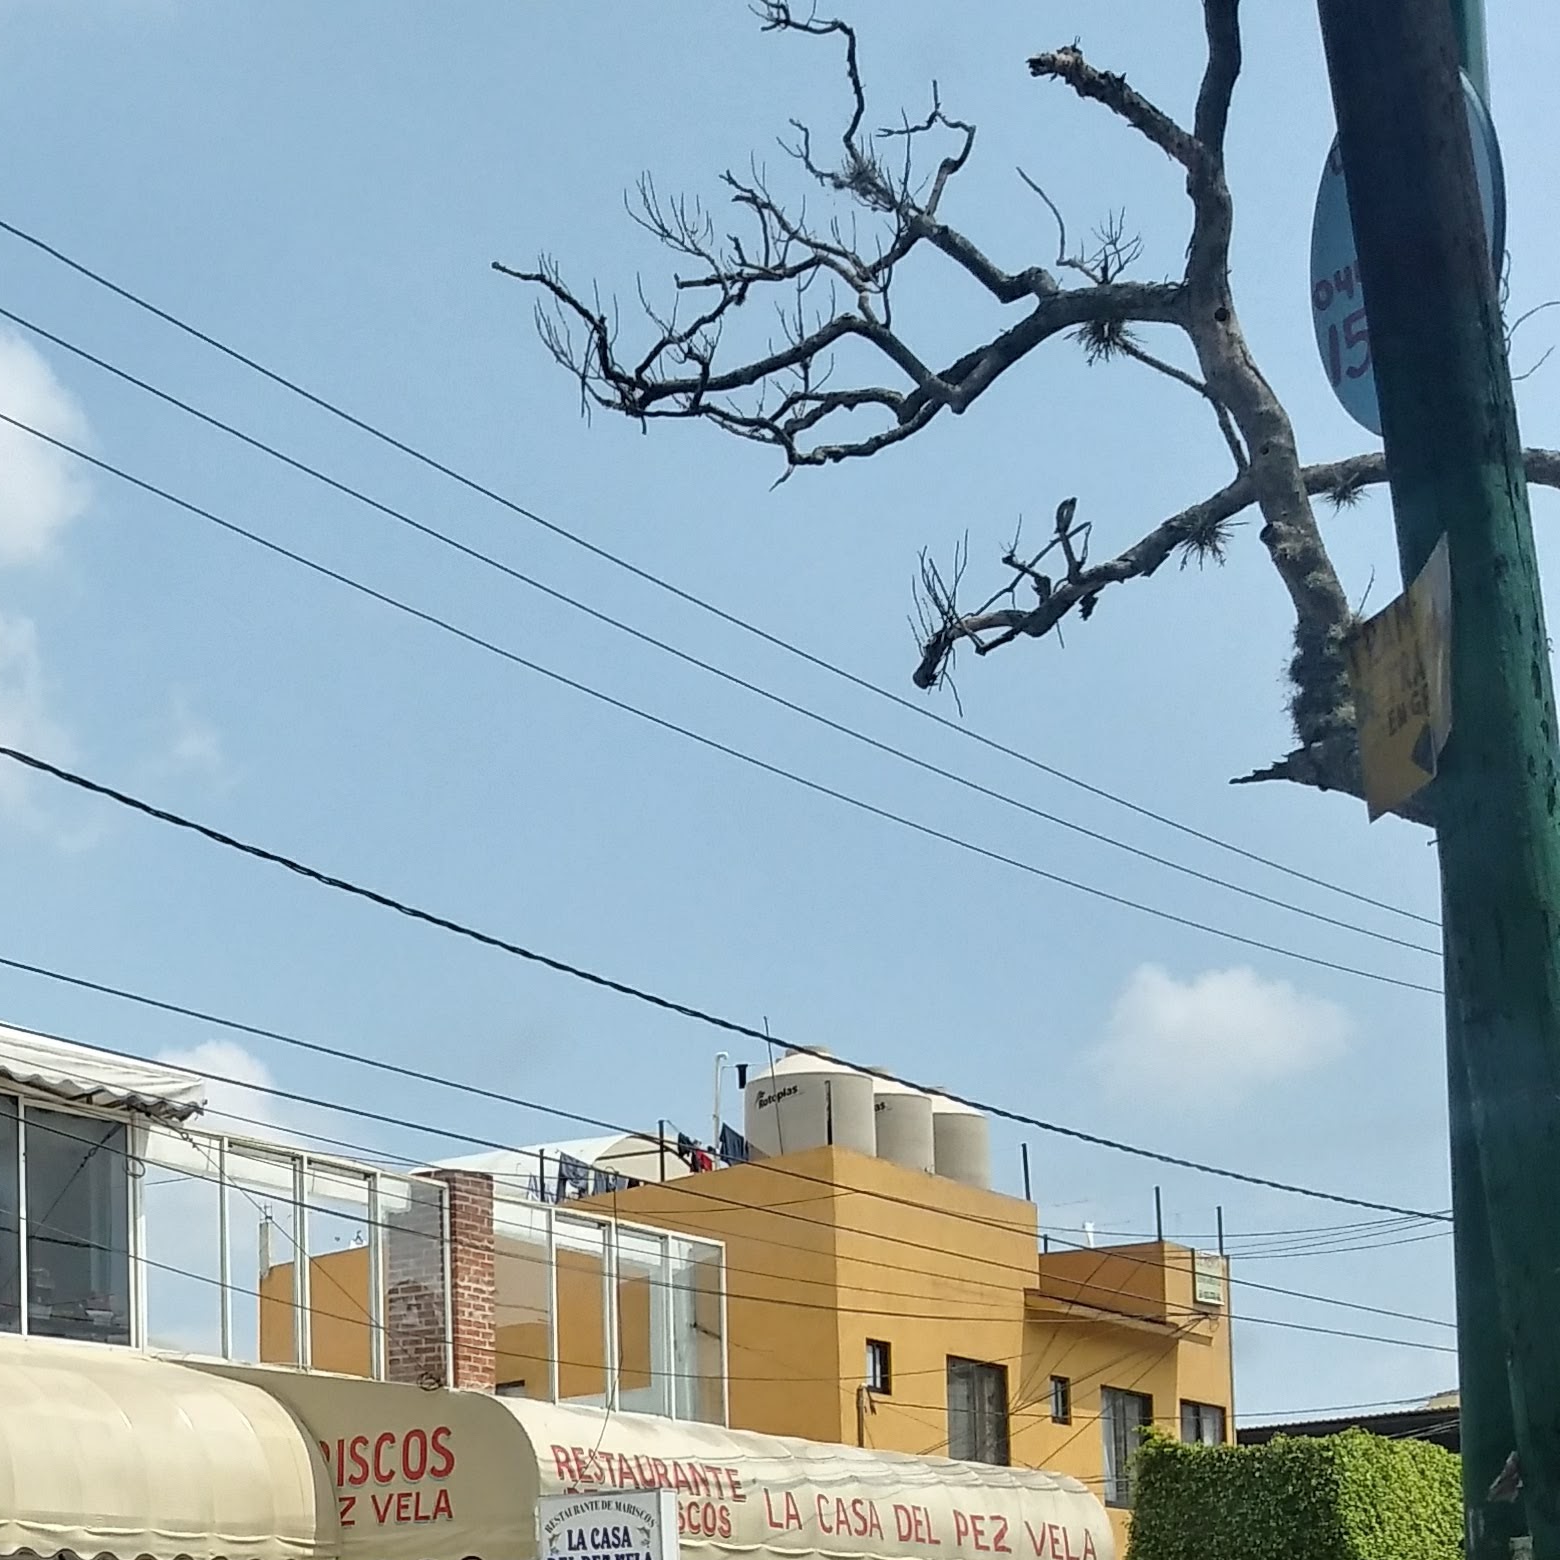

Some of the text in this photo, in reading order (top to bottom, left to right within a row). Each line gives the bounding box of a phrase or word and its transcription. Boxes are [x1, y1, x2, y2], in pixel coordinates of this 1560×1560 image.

[550, 1444, 747, 1503] RESTAURANTE
[371, 1489, 454, 1525] VELA
[544, 1500, 657, 1534] RESTAURANTE DE MARISCOS
[763, 1487, 803, 1531] LA
[816, 1493, 885, 1542] CASA
[893, 1503, 941, 1546] DEL
[953, 1509, 1012, 1554] PEZ
[567, 1526, 632, 1551] LA CASA
